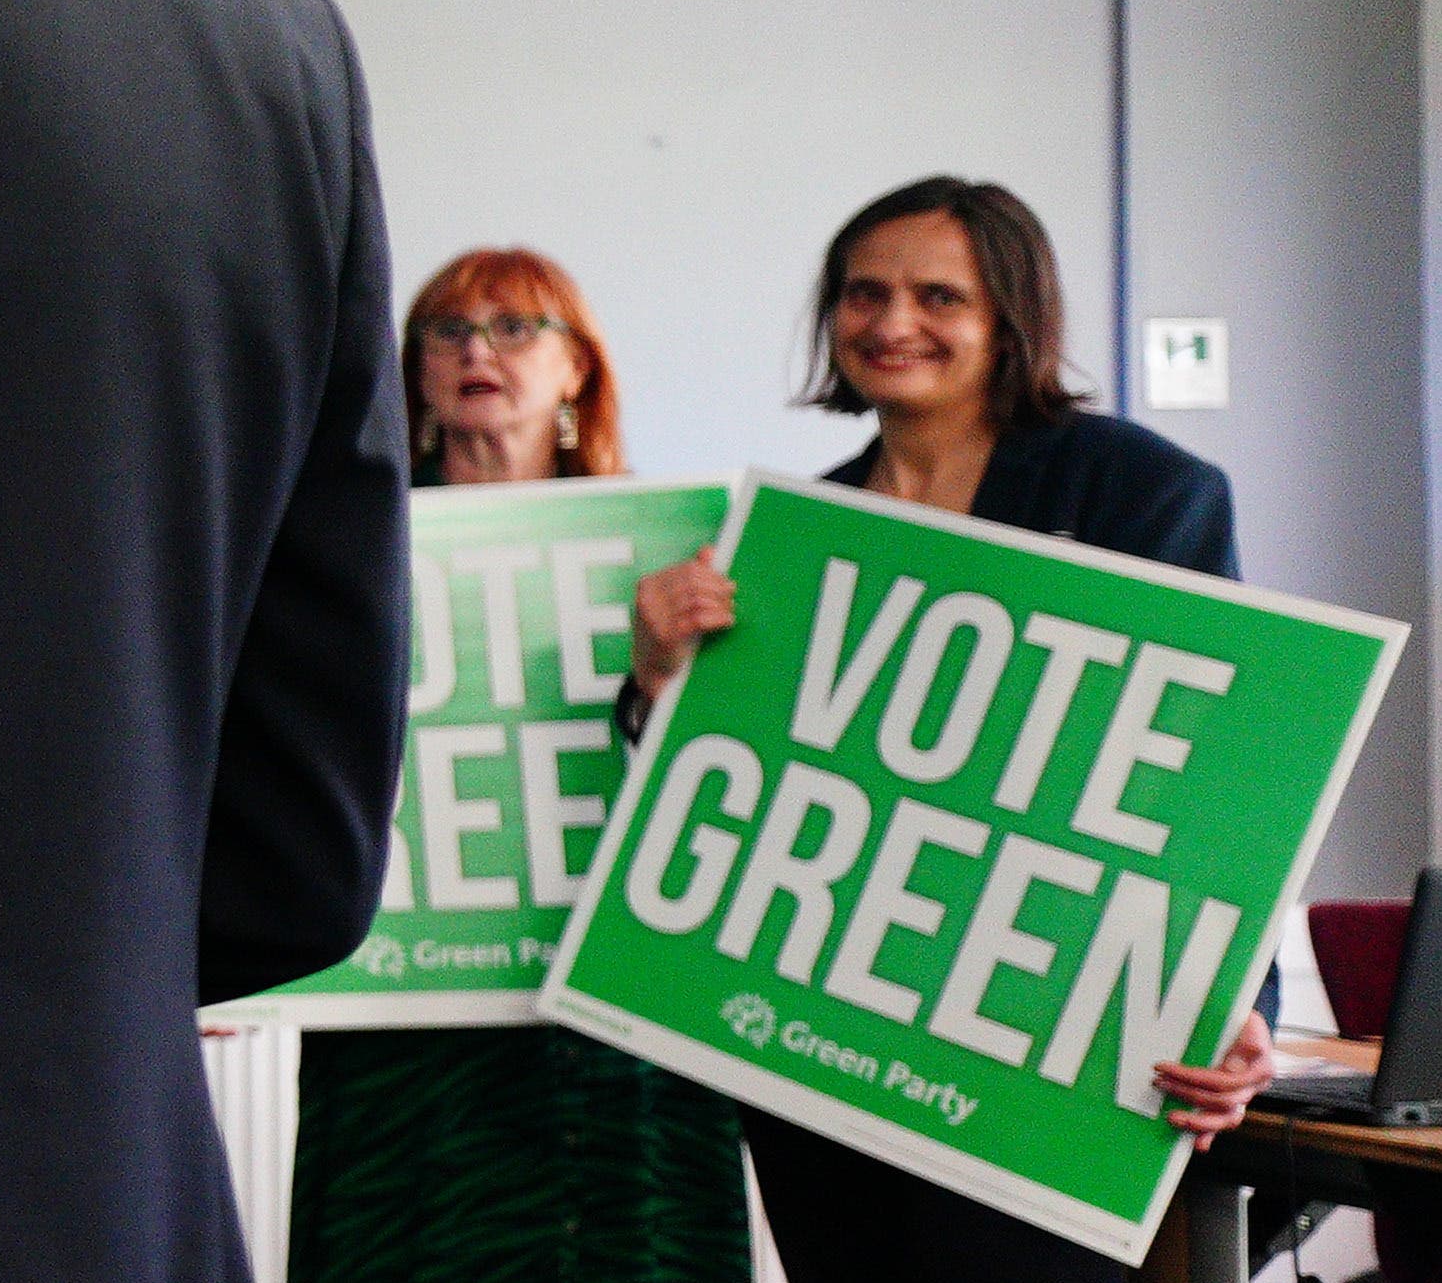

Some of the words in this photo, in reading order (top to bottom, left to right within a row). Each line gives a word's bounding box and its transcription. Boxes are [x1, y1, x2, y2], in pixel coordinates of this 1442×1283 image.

[411, 538, 633, 716] OTE
[789, 555, 1237, 858] VOTE
[626, 732, 1242, 1120] GREEN
[779, 1018, 882, 1086] Green
[883, 1059, 980, 1127] Party
